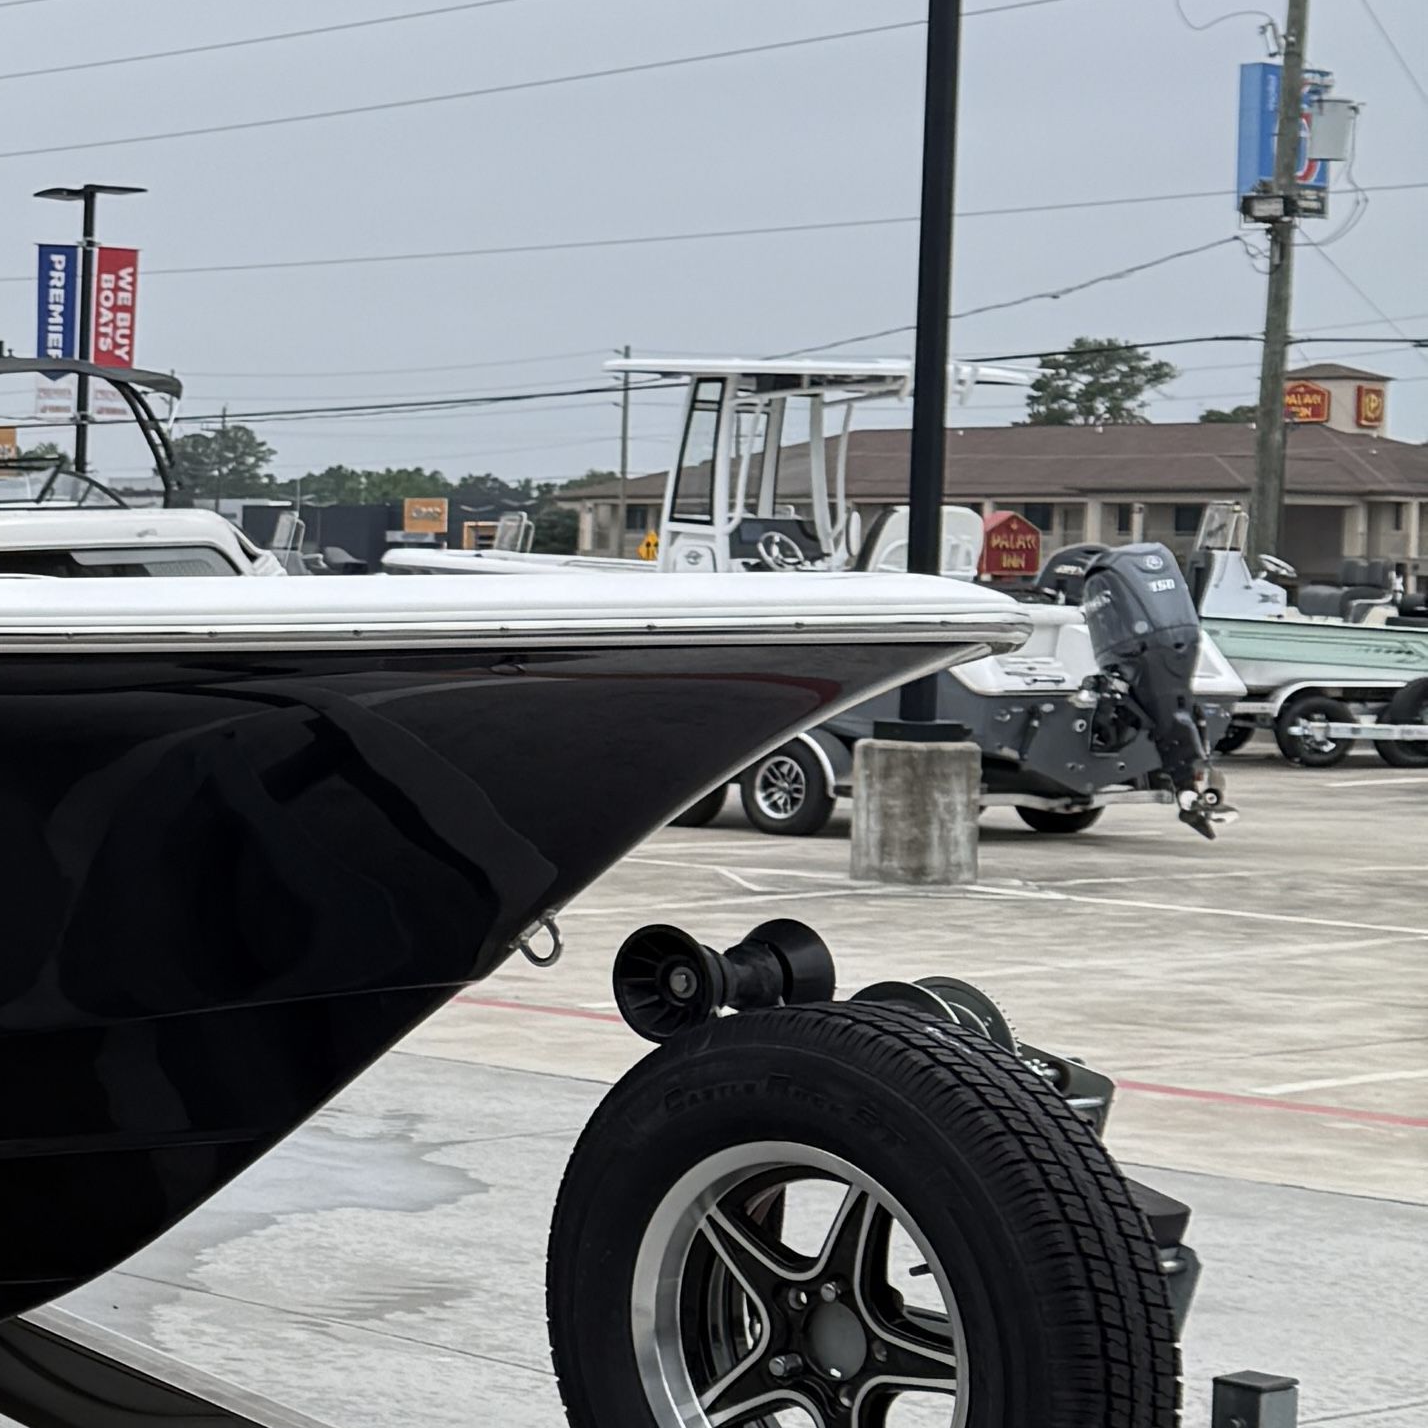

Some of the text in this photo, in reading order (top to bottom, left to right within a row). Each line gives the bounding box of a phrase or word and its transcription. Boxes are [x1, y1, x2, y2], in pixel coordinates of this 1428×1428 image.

[98, 273, 115, 352] BOATS
[114, 267, 134, 361] WE BUY
